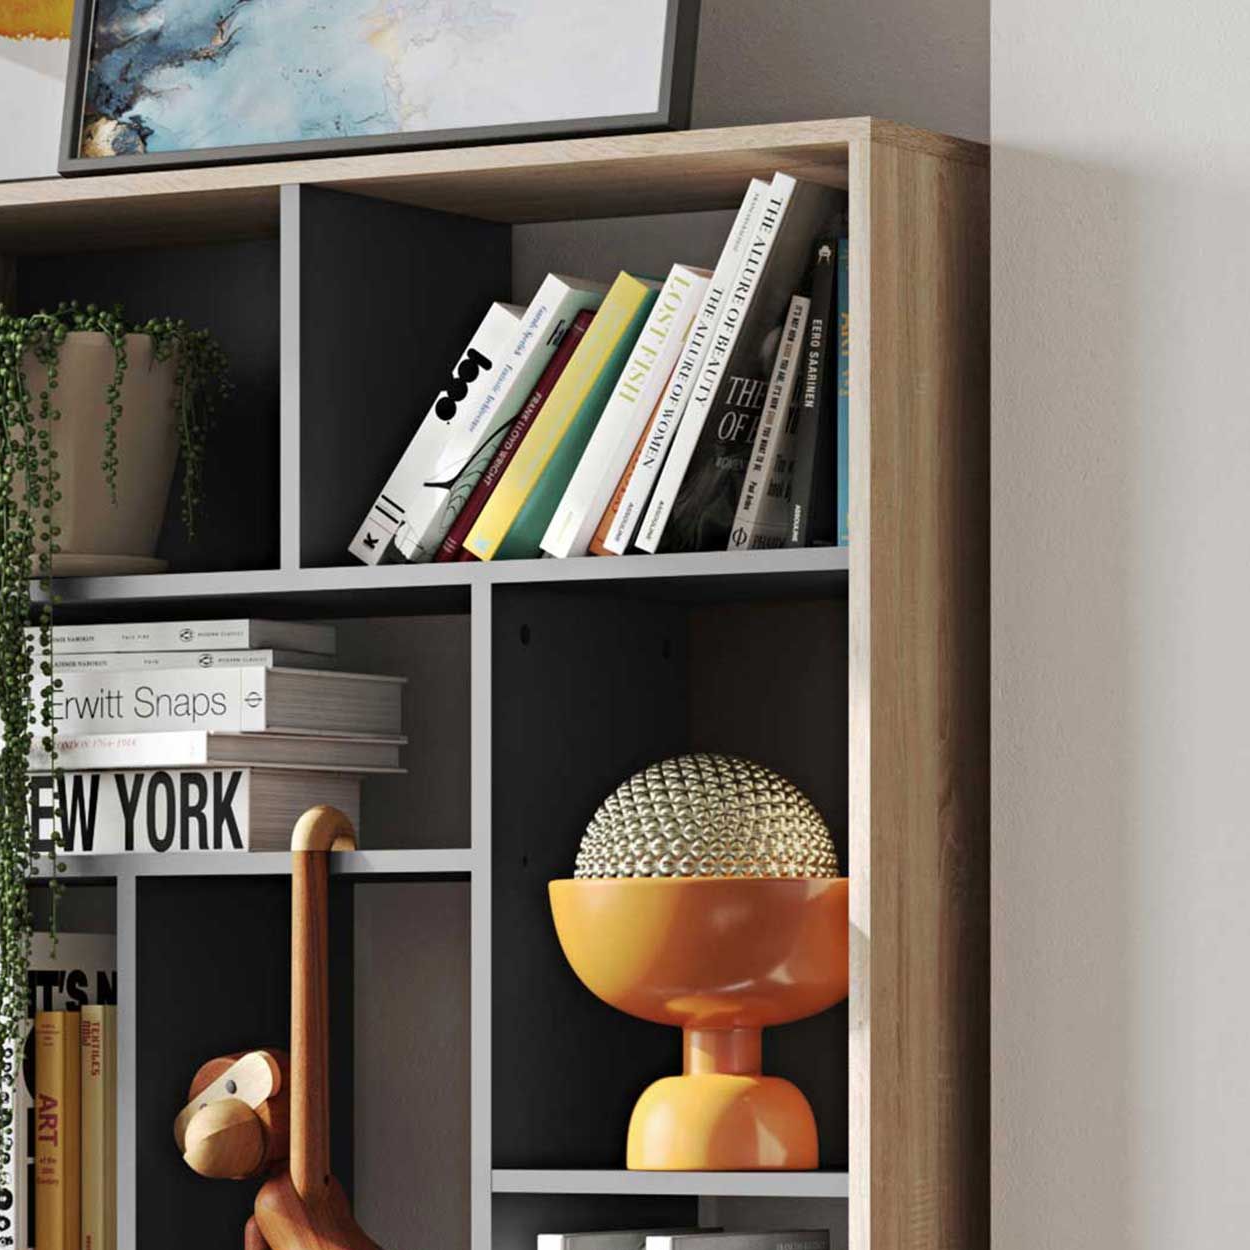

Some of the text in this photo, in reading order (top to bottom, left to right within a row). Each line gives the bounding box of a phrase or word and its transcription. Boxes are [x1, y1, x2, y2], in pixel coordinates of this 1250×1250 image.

[760, 196, 782, 234] THE
[734, 236, 767, 305] ALLURE
[648, 275, 692, 344] LOST
[723, 308, 740, 333] OF
[618, 345, 658, 403] FISH
[642, 287, 723, 469] THE ALLURE OF WOMEN
[695, 335, 730, 407] BEAUTY
[805, 319, 822, 408] EERO SAARINEN
[484, 391, 542, 486] FRANK LLOYD WRIGHT
[718, 411, 749, 441] OF
[363, 532, 379, 550] K
[52, 688, 124, 719] Erwitt
[134, 686, 227, 723] Snaps
[28, 770, 244, 853] EW YORK
[28, 970, 88, 1018] IT'S
[38, 1093, 59, 1147] ART
